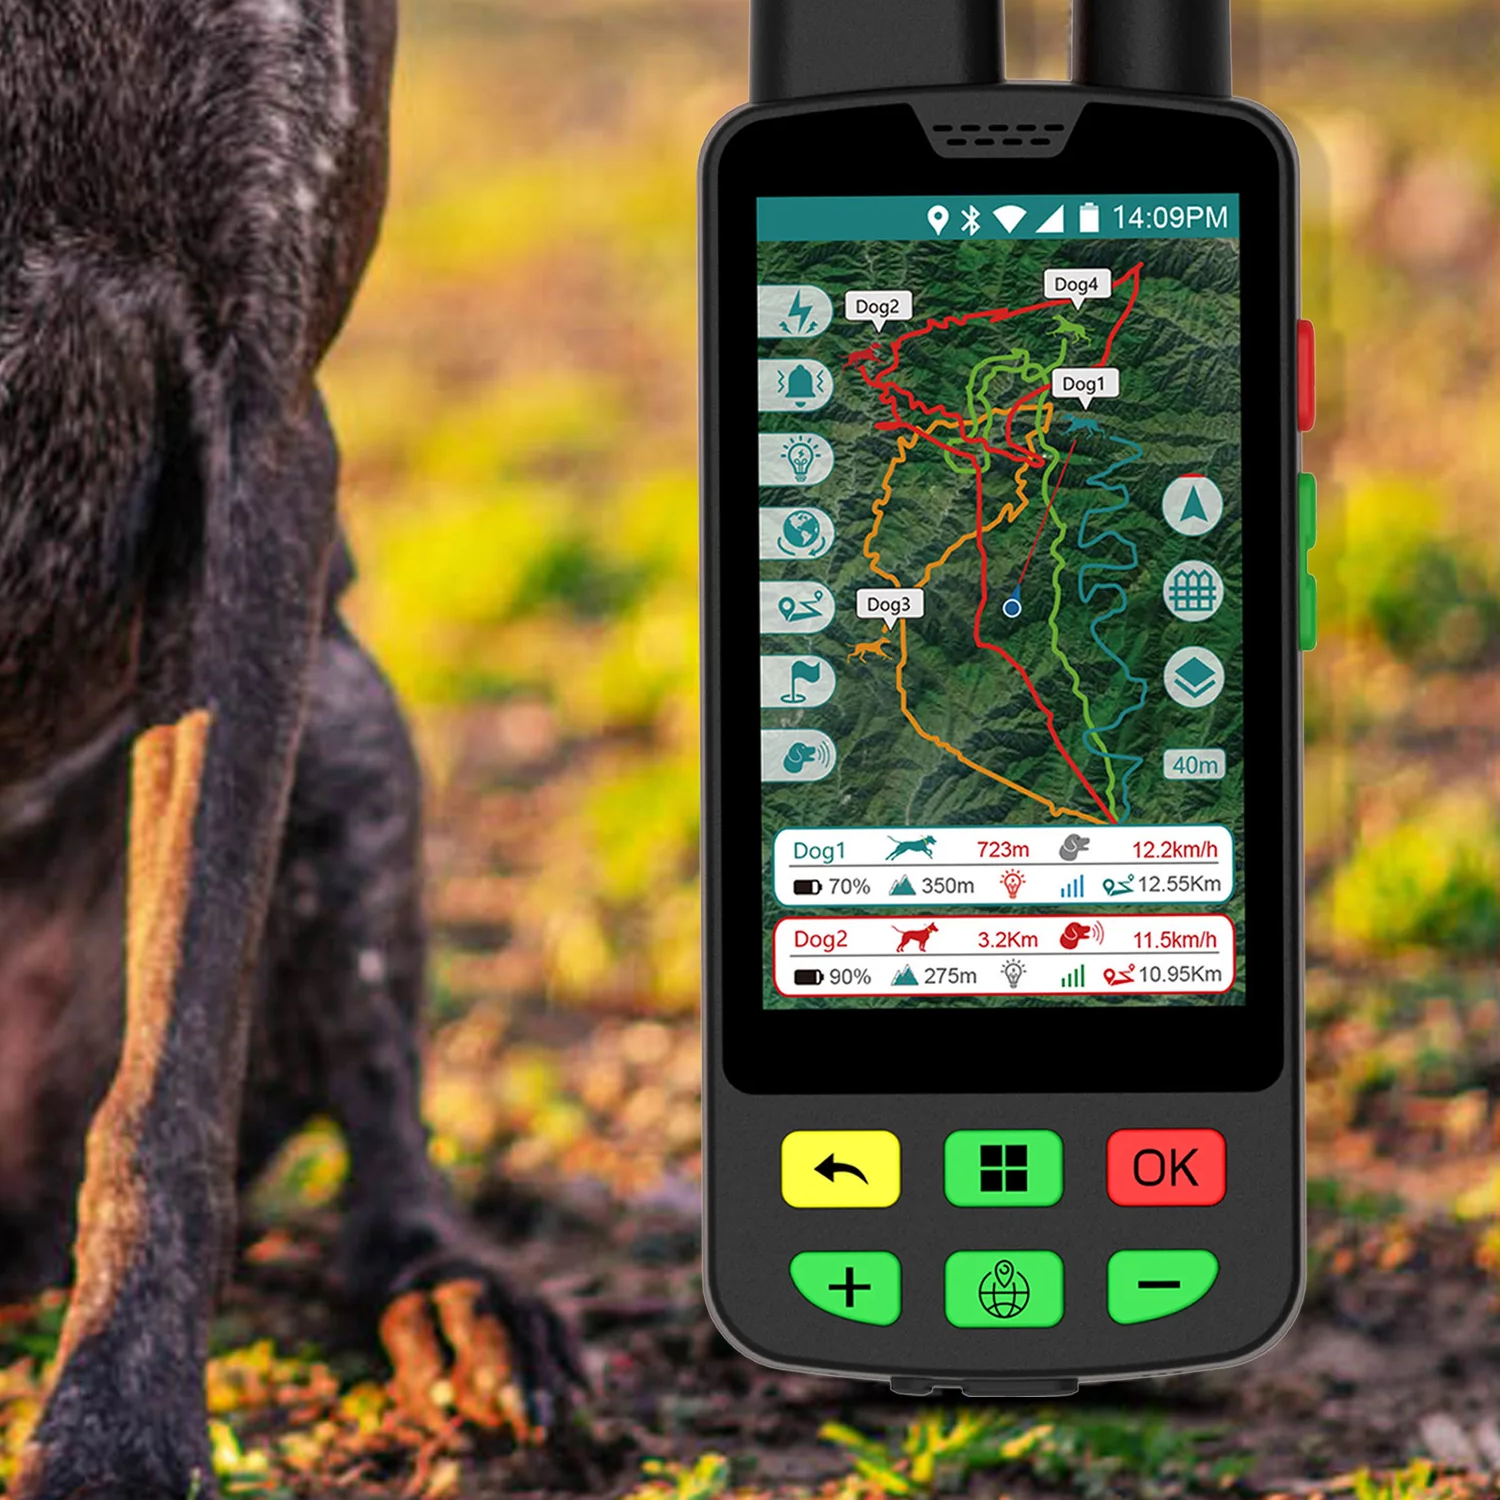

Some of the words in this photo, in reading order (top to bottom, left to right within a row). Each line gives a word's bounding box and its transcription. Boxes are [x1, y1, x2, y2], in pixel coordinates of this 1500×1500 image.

[1113, 204, 1228, 229] 14:09PM
[1055, 276, 1099, 295] Dog4
[856, 298, 900, 318] Dog2
[1063, 376, 1104, 395] Dog1
[867, 596, 911, 616] Dog3
[1172, 755, 1218, 775] 40m
[793, 841, 844, 865] Dog1
[977, 840, 1030, 858] 723m
[1132, 840, 1218, 859] 12.2km/h
[828, 877, 871, 895] 70%
[922, 877, 975, 894] 350m
[1138, 875, 1222, 893] 12.55Km
[794, 929, 848, 953] Dog2
[978, 931, 1039, 949] 3.2Km
[1133, 930, 1217, 949] 11.5km/h
[829, 967, 872, 985] 90%
[924, 967, 977, 985] 275m
[1139, 965, 1222, 983] 10.95Km
[1133, 1147, 1199, 1187] OK
